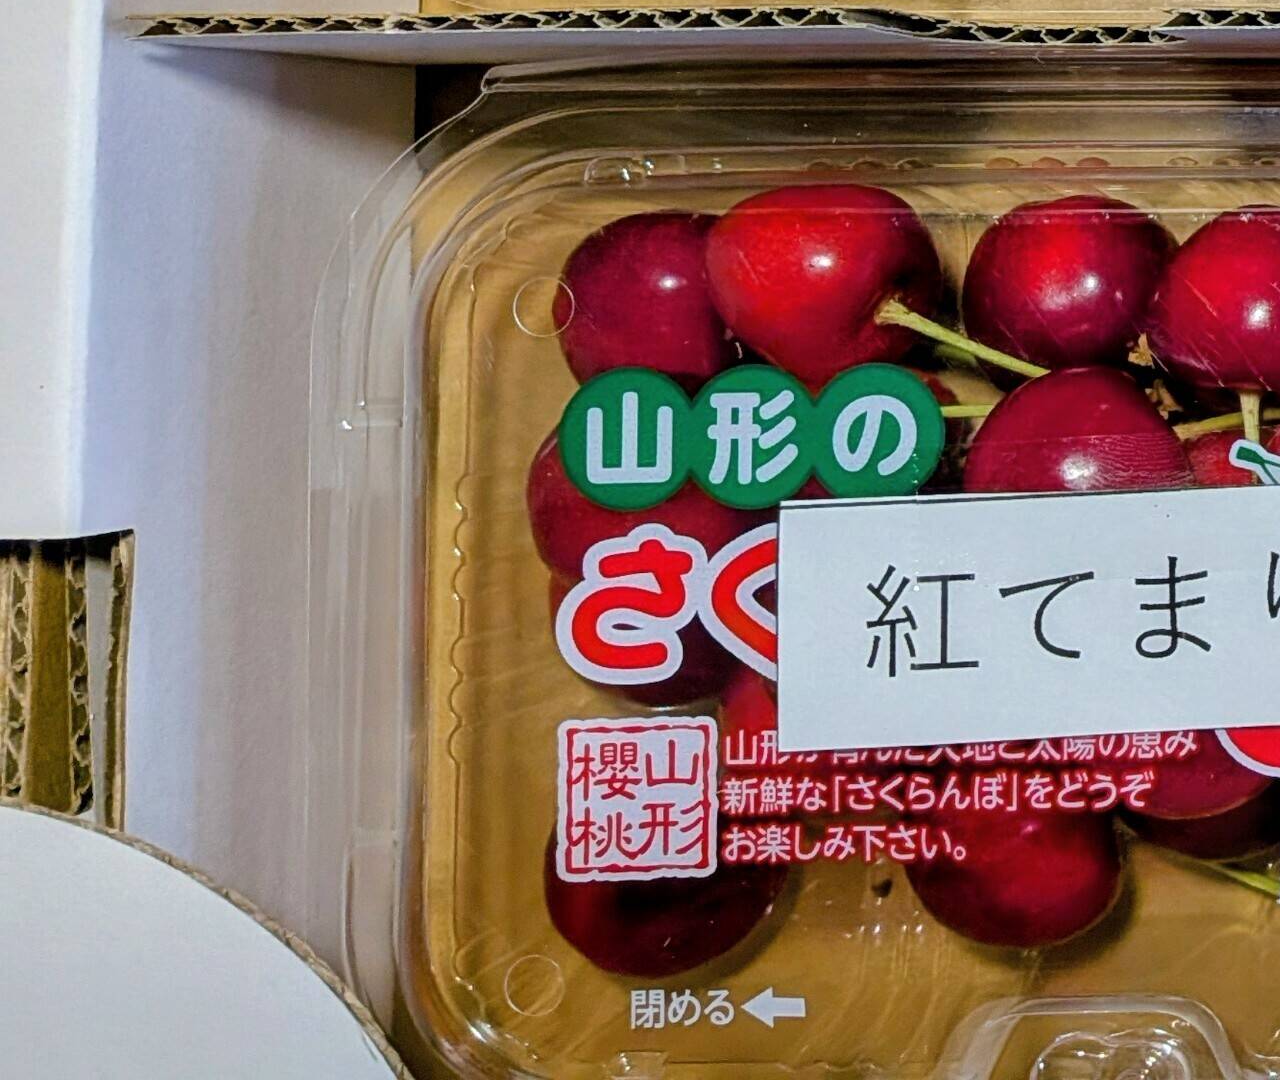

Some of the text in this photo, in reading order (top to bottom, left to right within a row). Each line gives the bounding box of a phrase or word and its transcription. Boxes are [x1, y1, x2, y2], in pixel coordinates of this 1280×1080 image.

[587, 390, 917, 484] 山形の
[724, 772, 1154, 814] 新鮮な「さくらんぼ」をどうぞ
[725, 825, 967, 862] お楽しみ下さい。
[631, 989, 735, 1028] 閉める
